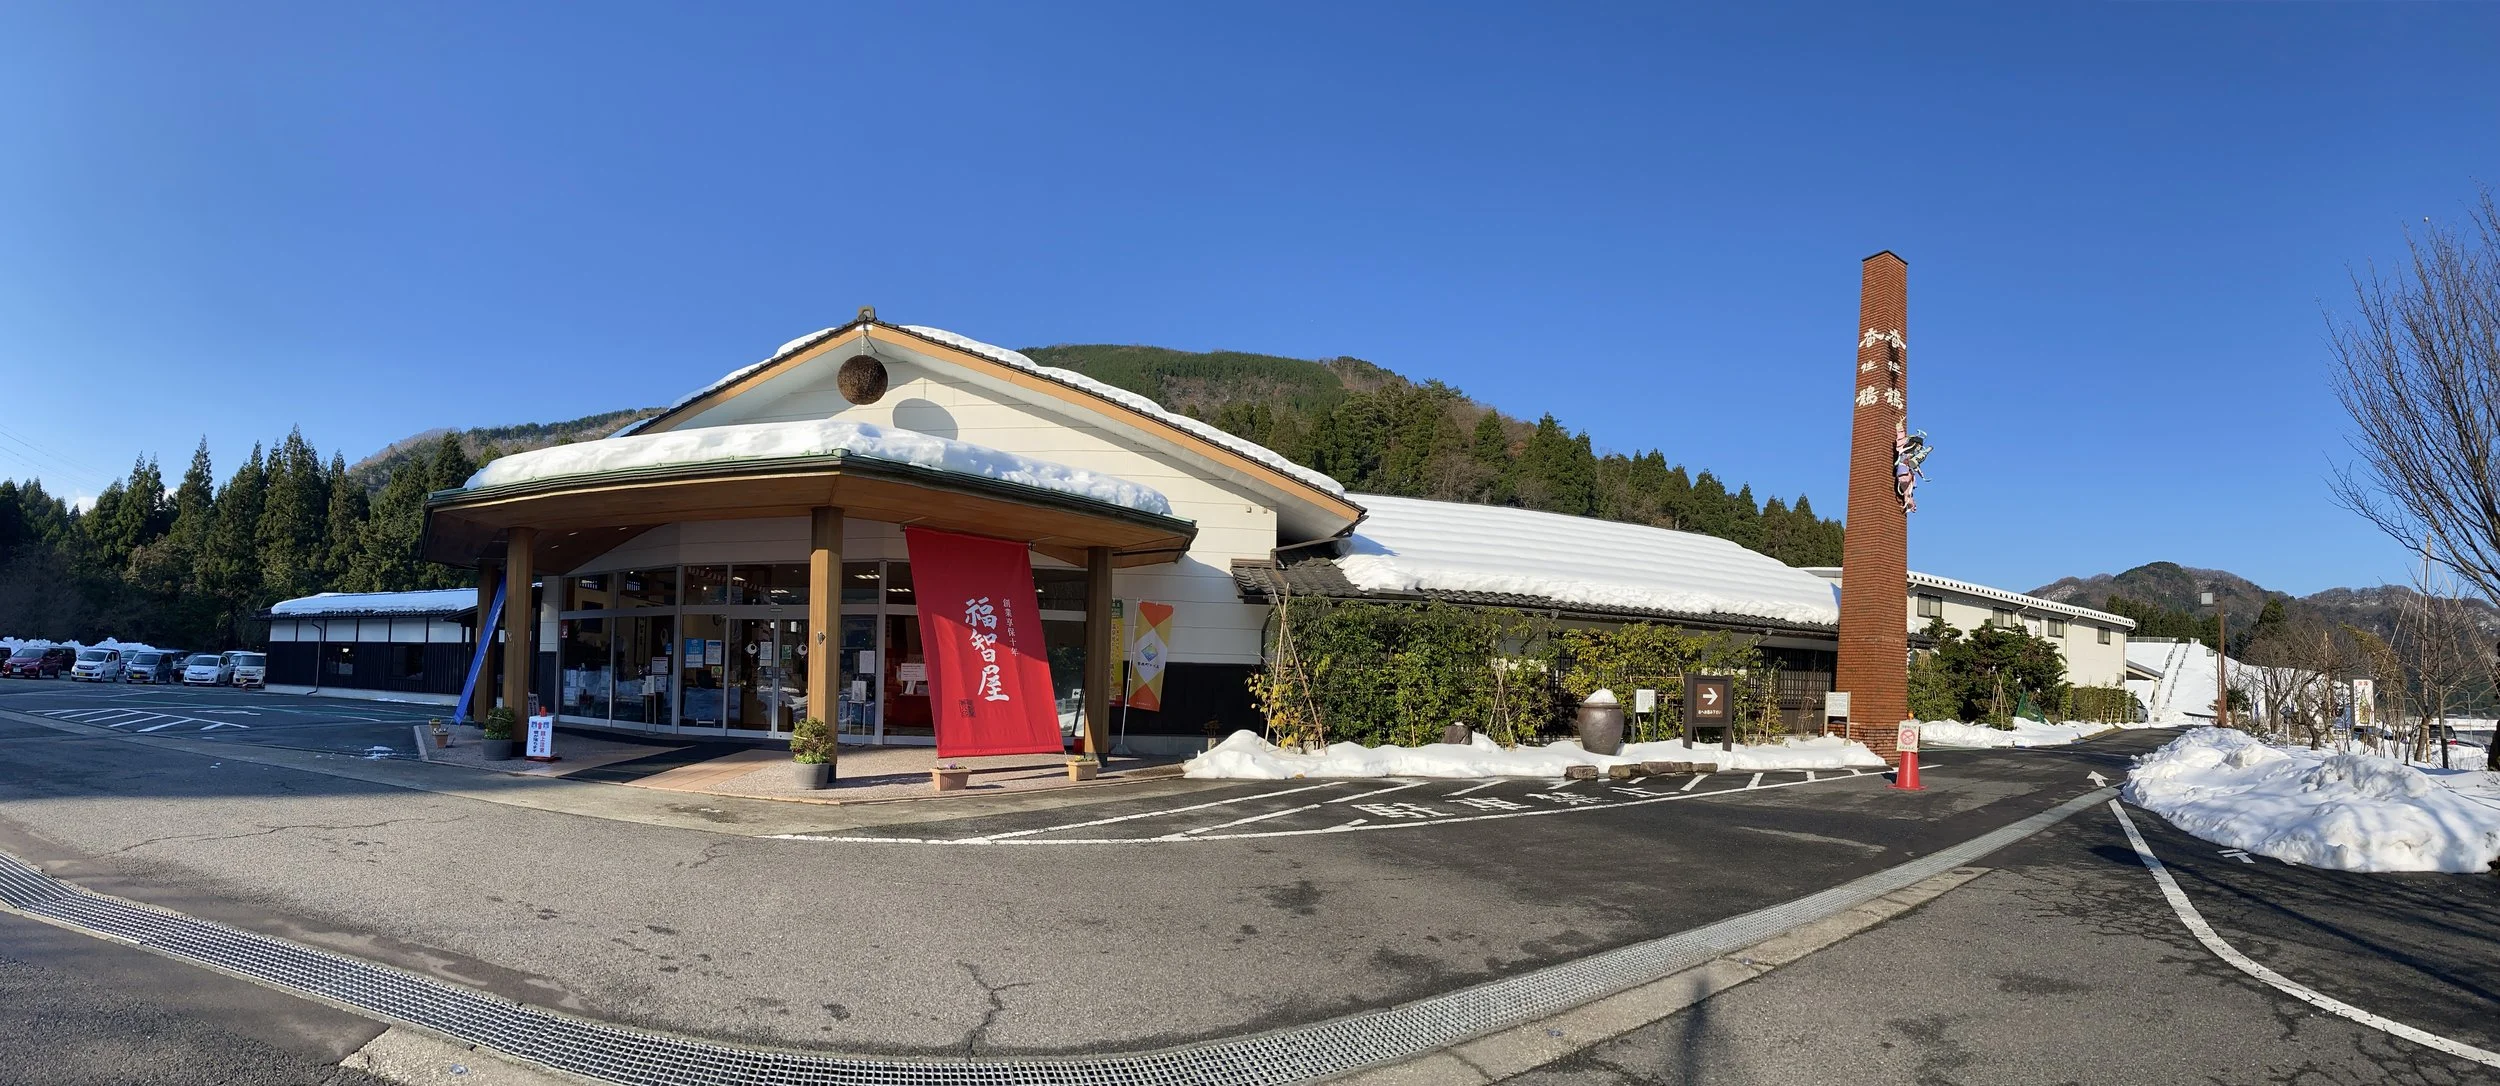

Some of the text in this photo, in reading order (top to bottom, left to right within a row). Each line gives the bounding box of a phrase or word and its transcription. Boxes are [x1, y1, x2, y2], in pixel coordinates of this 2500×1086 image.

[1856, 327, 1885, 408] 香住鶴
[1884, 328, 1906, 410] 香住鶴
[965, 597, 1010, 702] 福智屋
[1002, 598, 1020, 657] 創業享保十年
